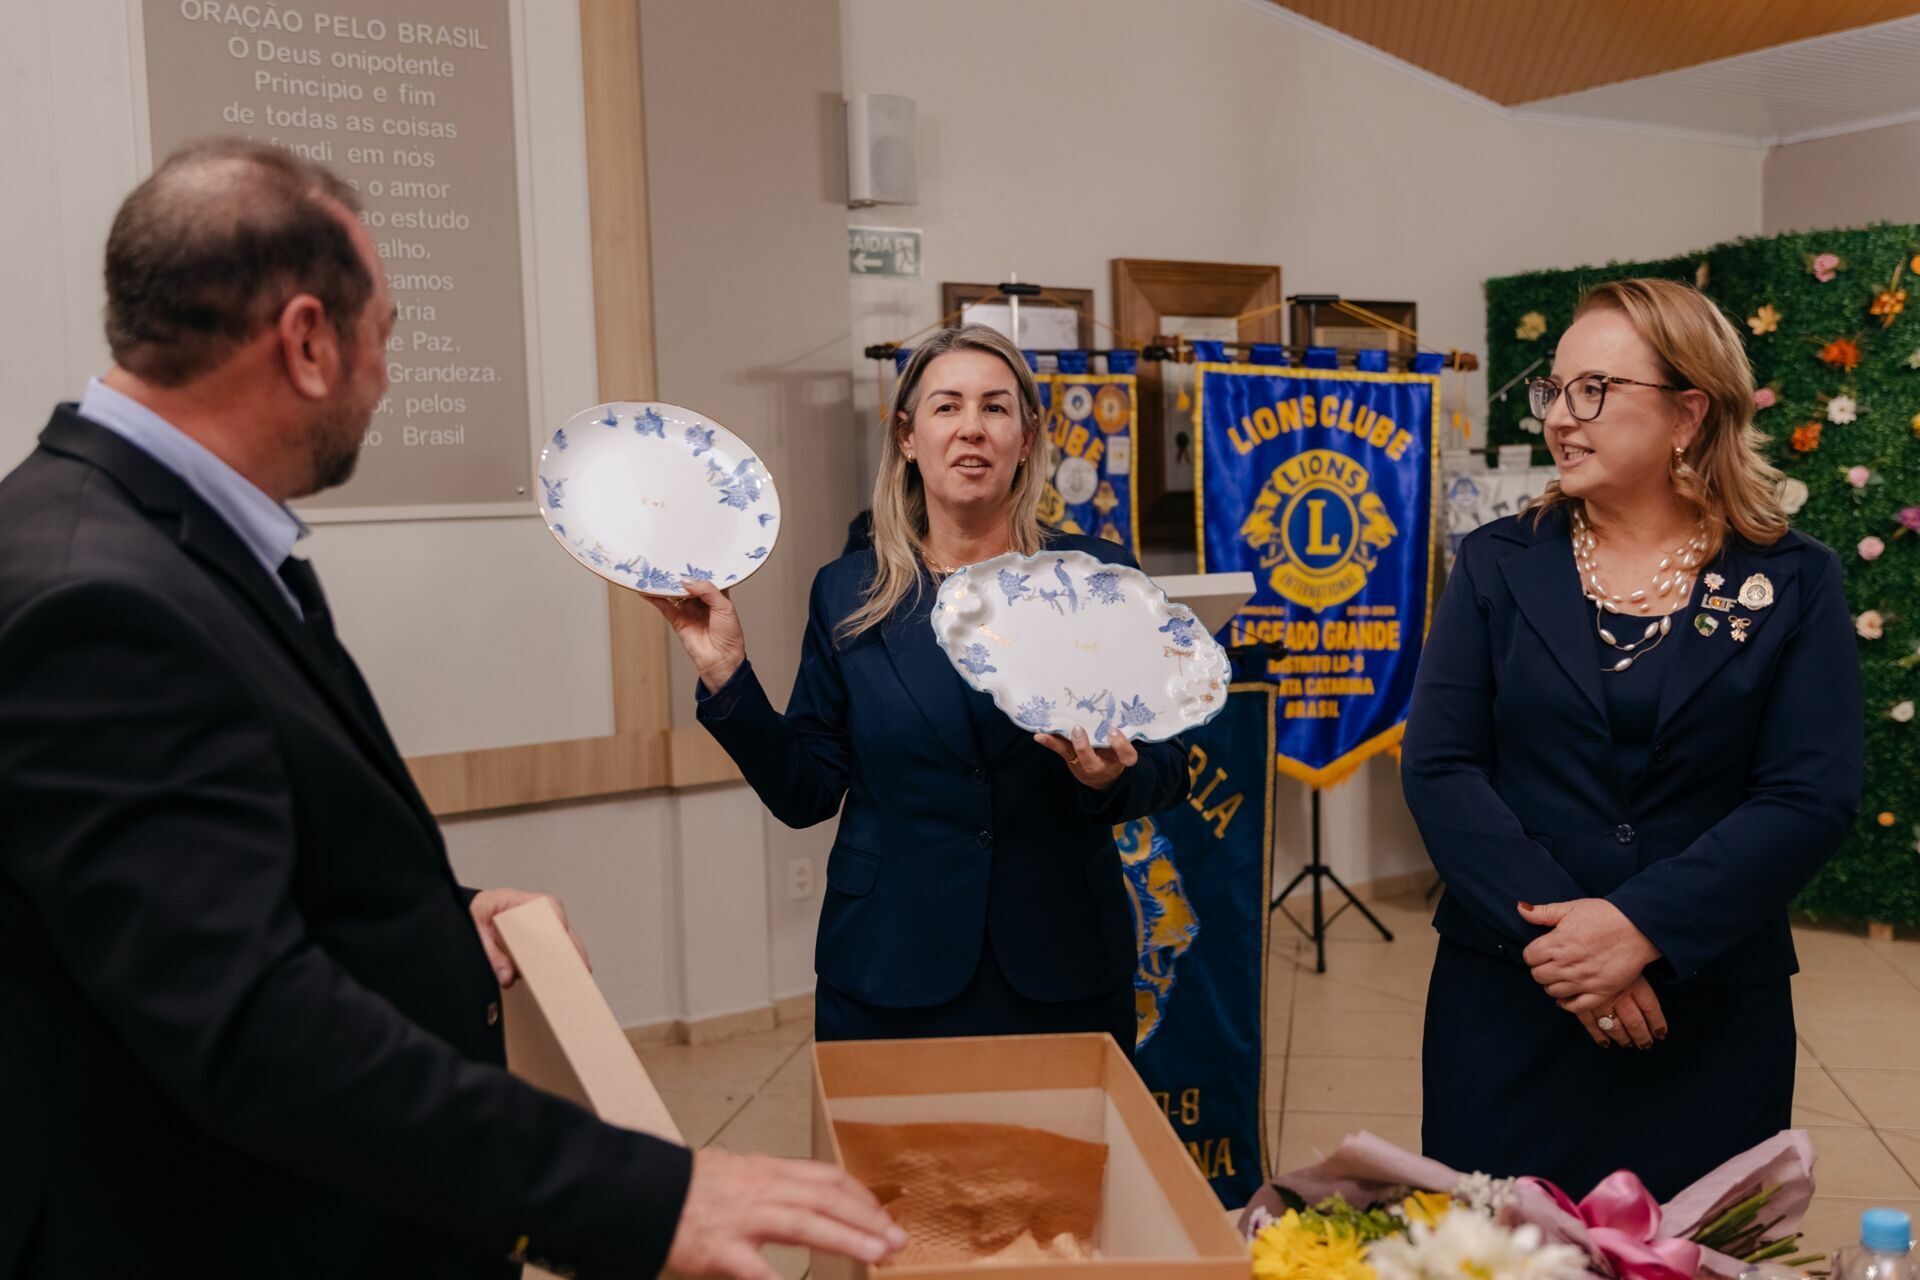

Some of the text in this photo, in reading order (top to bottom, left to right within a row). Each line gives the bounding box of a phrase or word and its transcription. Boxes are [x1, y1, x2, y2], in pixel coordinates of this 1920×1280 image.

[180, 0, 489, 50] ORAÇÃO PELO BRASIL
[256, 40, 323, 67] Deus
[332, 48, 456, 79] onipotente
[373, 84, 389, 103] e
[398, 83, 437, 108] fim
[222, 101, 458, 140] de todas as coisas
[347, 145, 385, 165] em
[368, 180, 384, 198] o
[390, 179, 451, 200] amor
[391, 208, 471, 232] estudo
[411, 331, 462, 355] Paz,
[386, 362, 502, 385] Grandeza.
[405, 391, 467, 417] pelos
[403, 424, 466, 447] Brasil
[1227, 394, 1414, 462] LIONS CLUBE
[1281, 455, 1362, 489] LIONS
[1304, 499, 1342, 556] L
[1322, 619, 1402, 651] GRANDE
[1283, 699, 1341, 719] BRASIL
